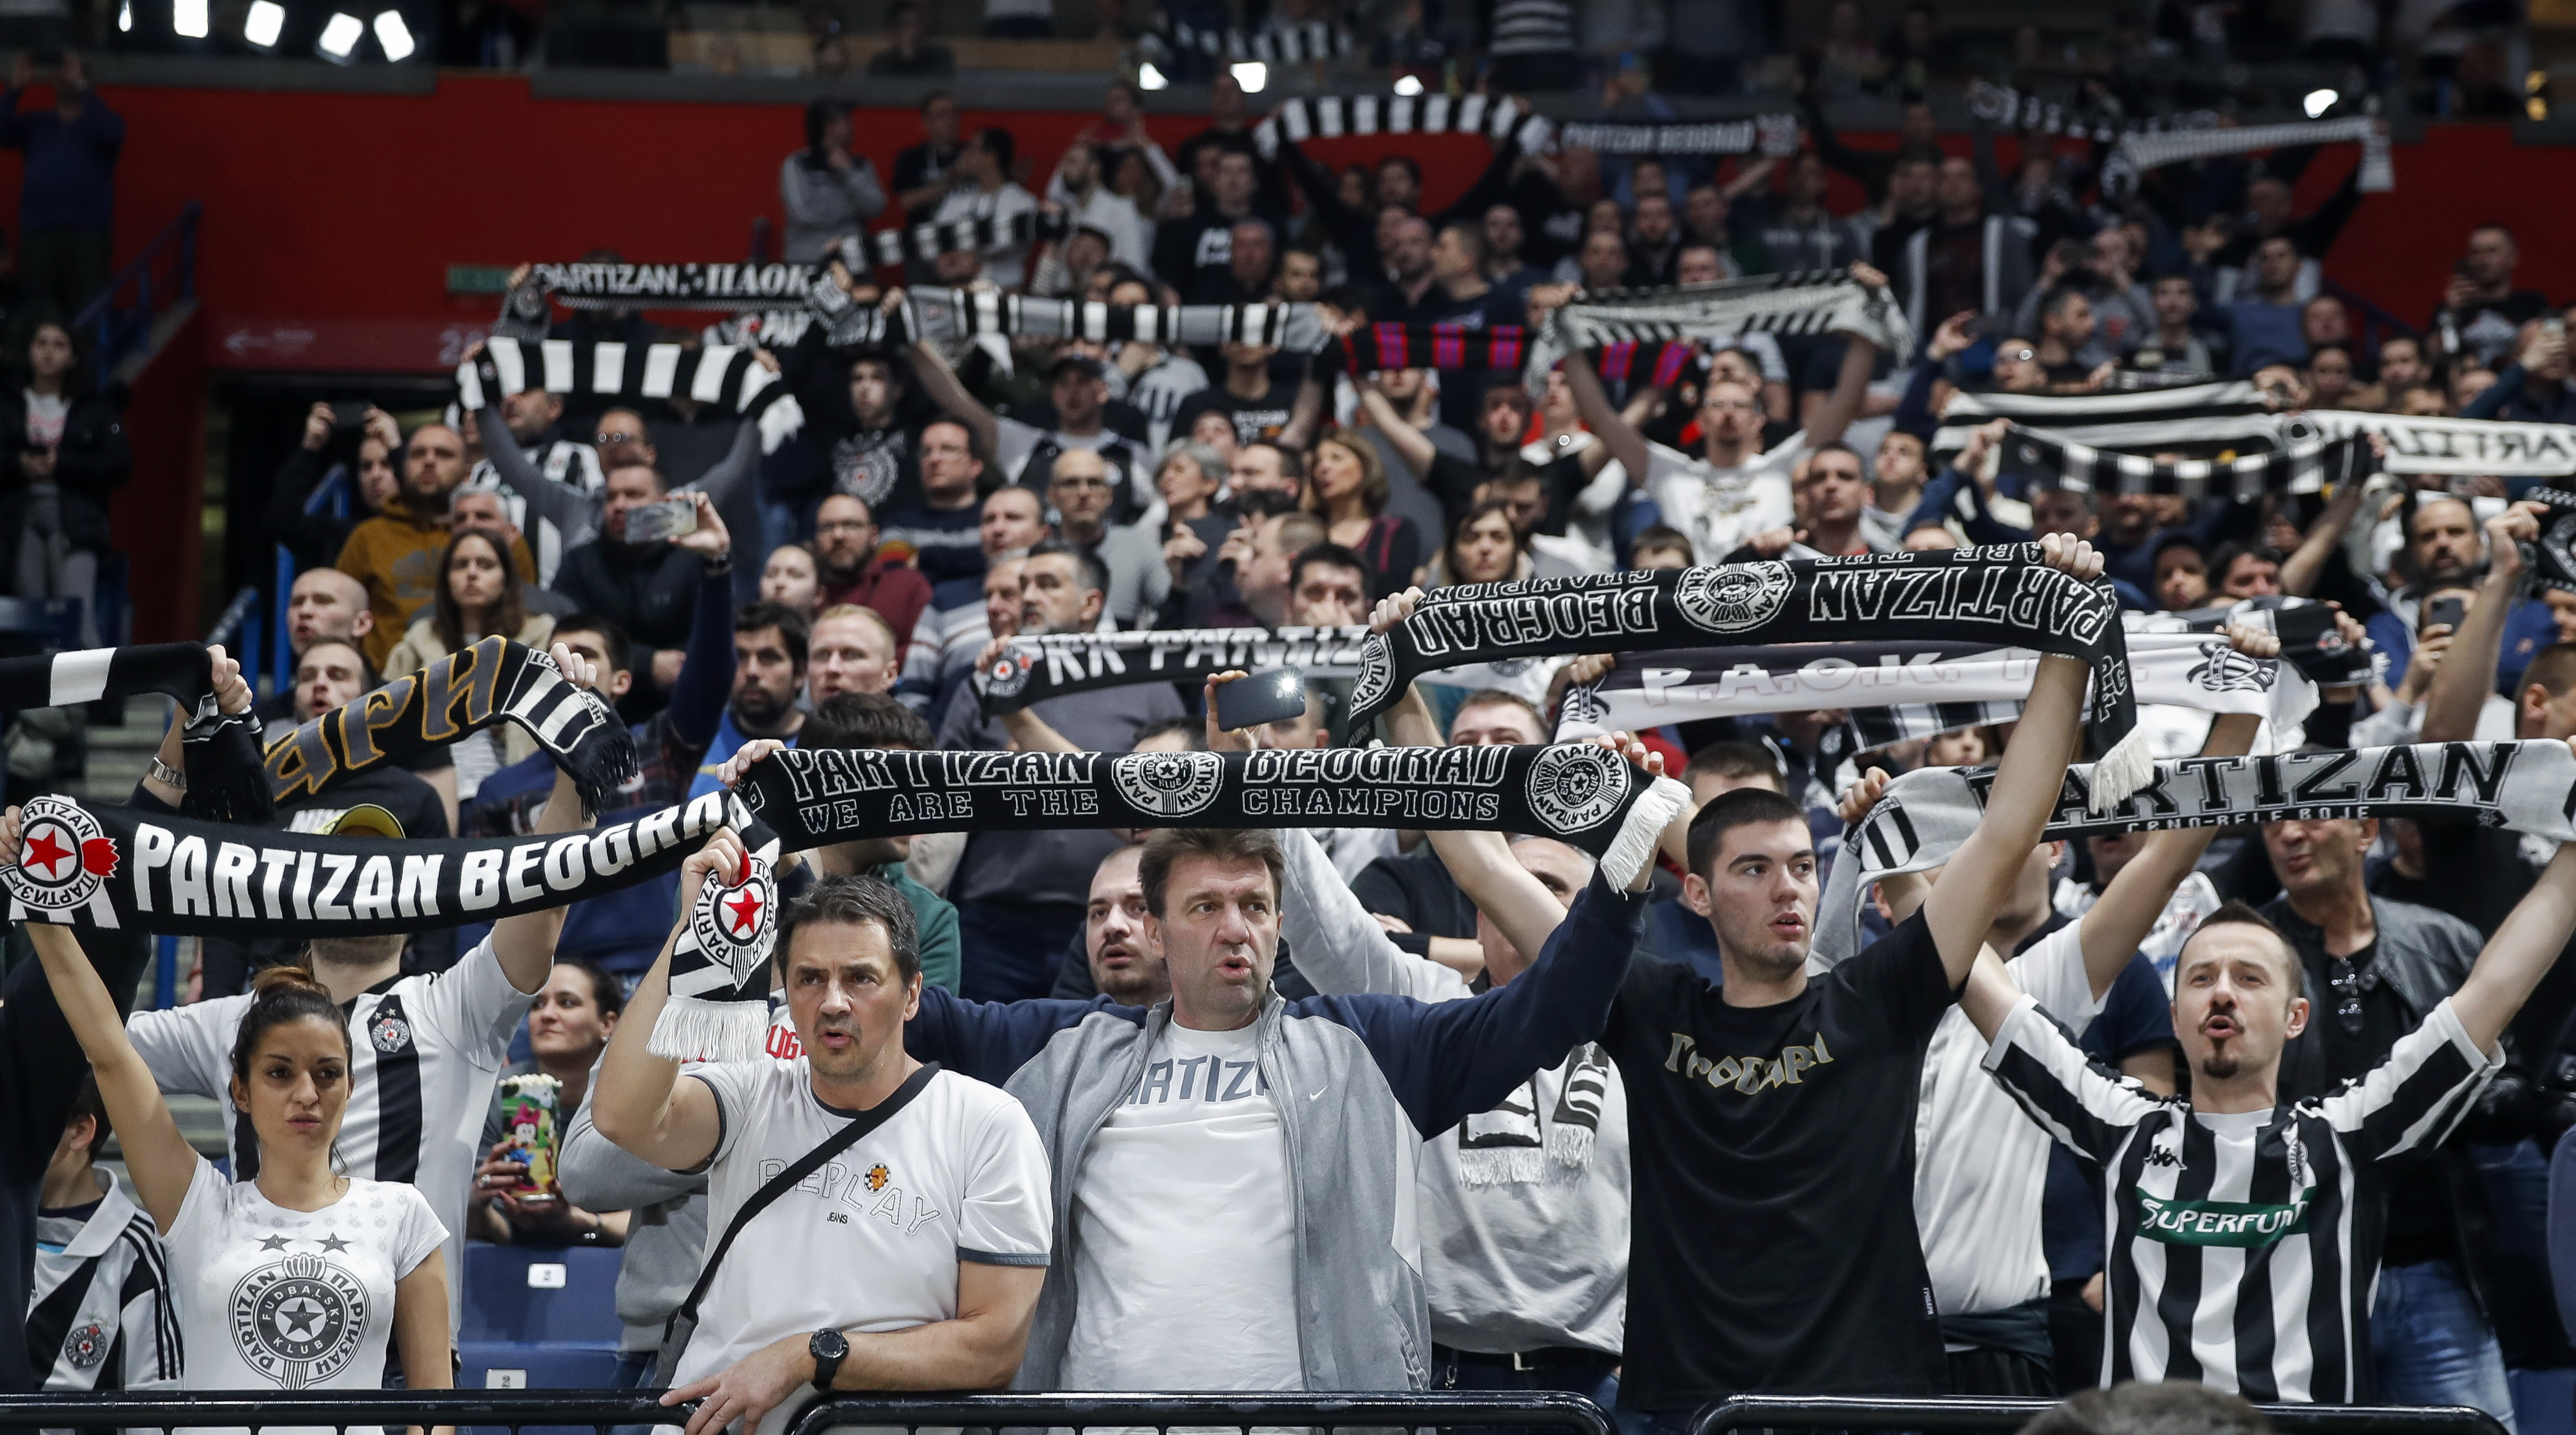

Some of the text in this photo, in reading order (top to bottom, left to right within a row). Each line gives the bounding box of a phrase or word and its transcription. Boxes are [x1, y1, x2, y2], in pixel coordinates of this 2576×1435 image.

[1404, 586, 1659, 656] BEOGRAD
[1810, 565, 2108, 646] PARTIZAN
[1144, 626, 1362, 672] PARTIZ
[773, 748, 1103, 803] PARTIZAN
[1242, 744, 1514, 787] BEOGRAD
[1953, 741, 2523, 825] ARTIZAN
[21, 802, 95, 839] RTIZAN
[800, 788, 1500, 835] WE ARE THE CHAMPIONS
[133, 822, 444, 921] PARTIZAN
[696, 876, 731, 960] PARTIZA
[827, 1211, 848, 1224] JEANS
[236, 1270, 277, 1371] PARTIZAN
[262, 1285, 340, 1325] FUDBALSKI
[315, 1272, 364, 1375] ПАРТИЗАН
[273, 1336, 324, 1355] KLUB
